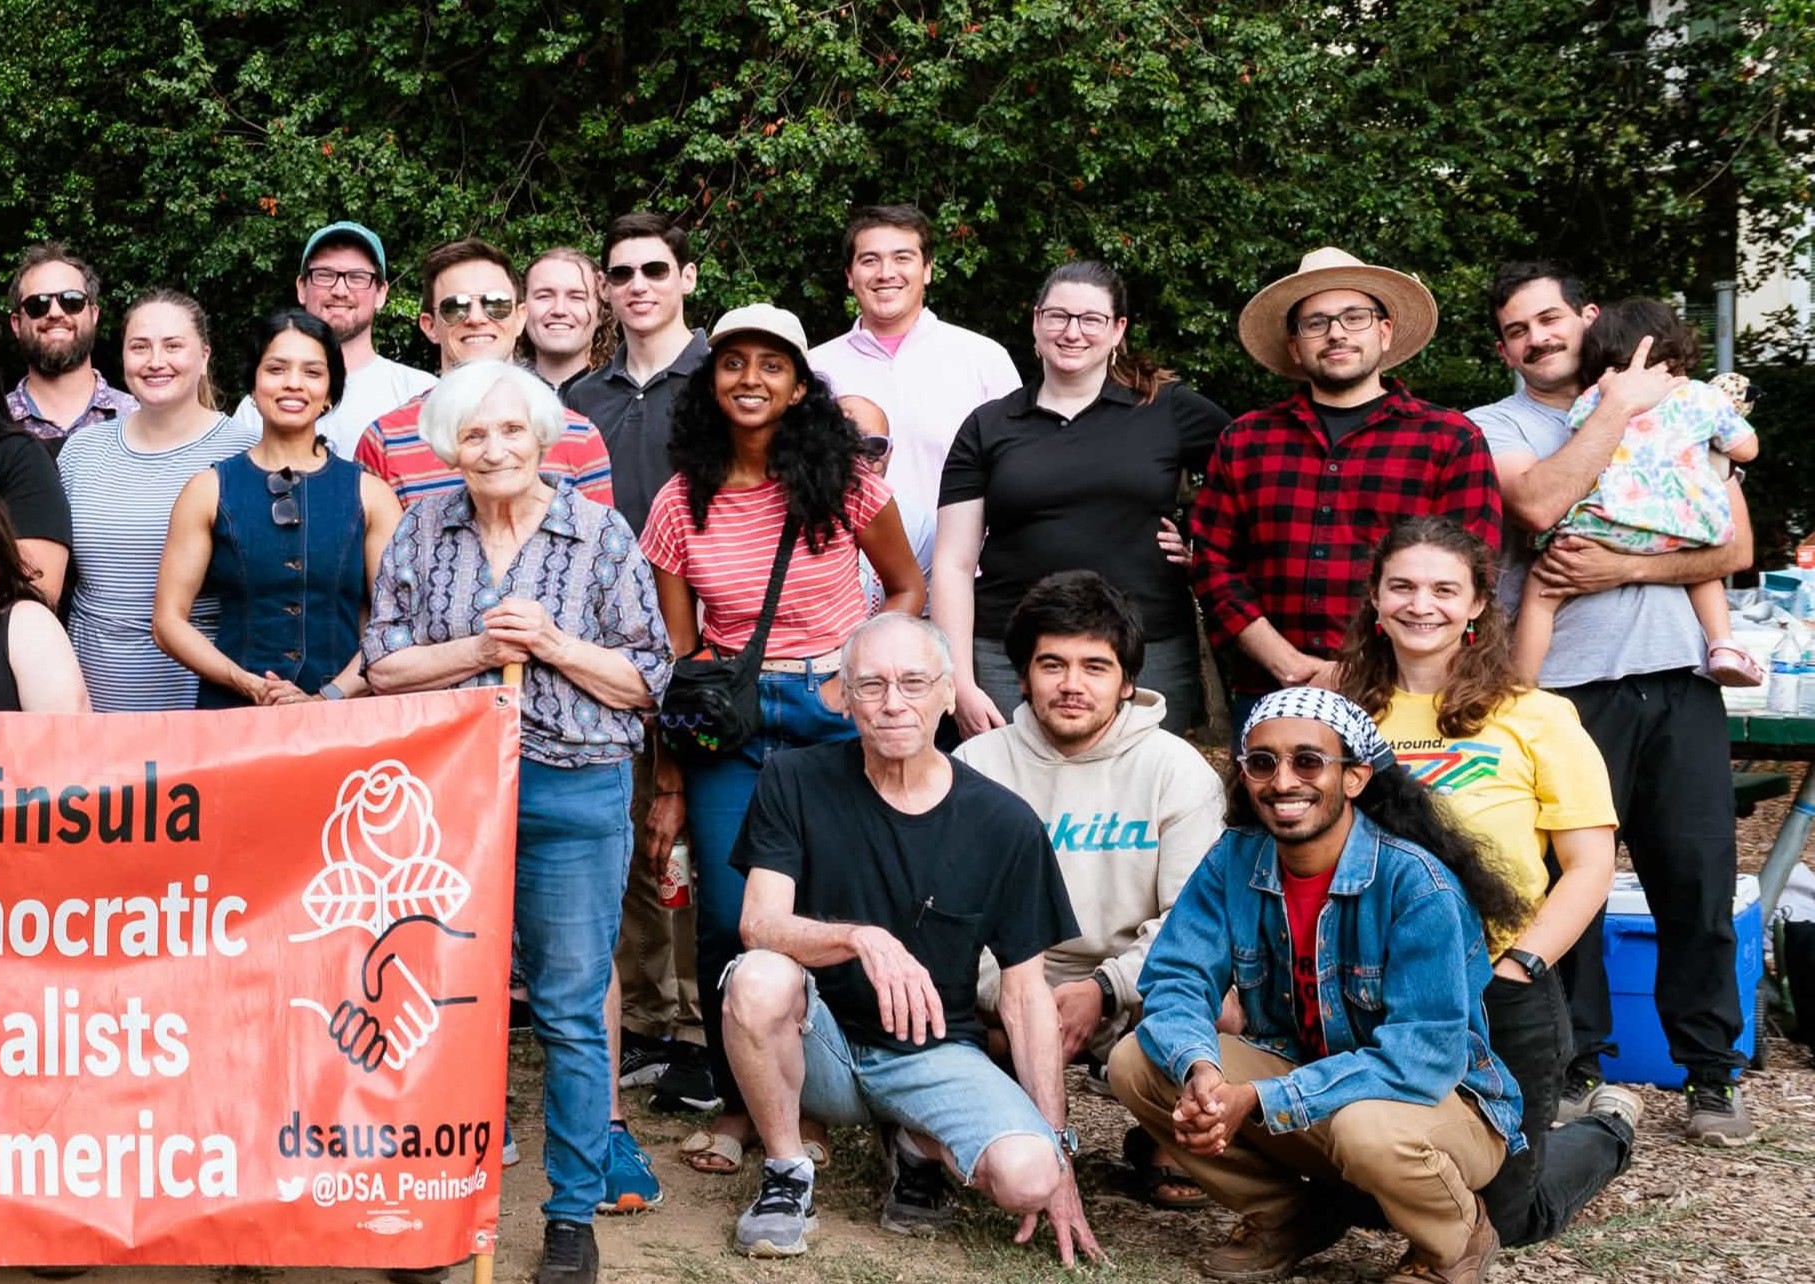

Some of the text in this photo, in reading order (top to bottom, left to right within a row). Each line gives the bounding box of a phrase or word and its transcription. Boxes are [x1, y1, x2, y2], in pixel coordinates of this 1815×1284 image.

[1045, 811, 1159, 851] kita
[278, 1110, 491, 1166] dsausa.org
[311, 1166, 488, 1208] @DSA_Peninsula
